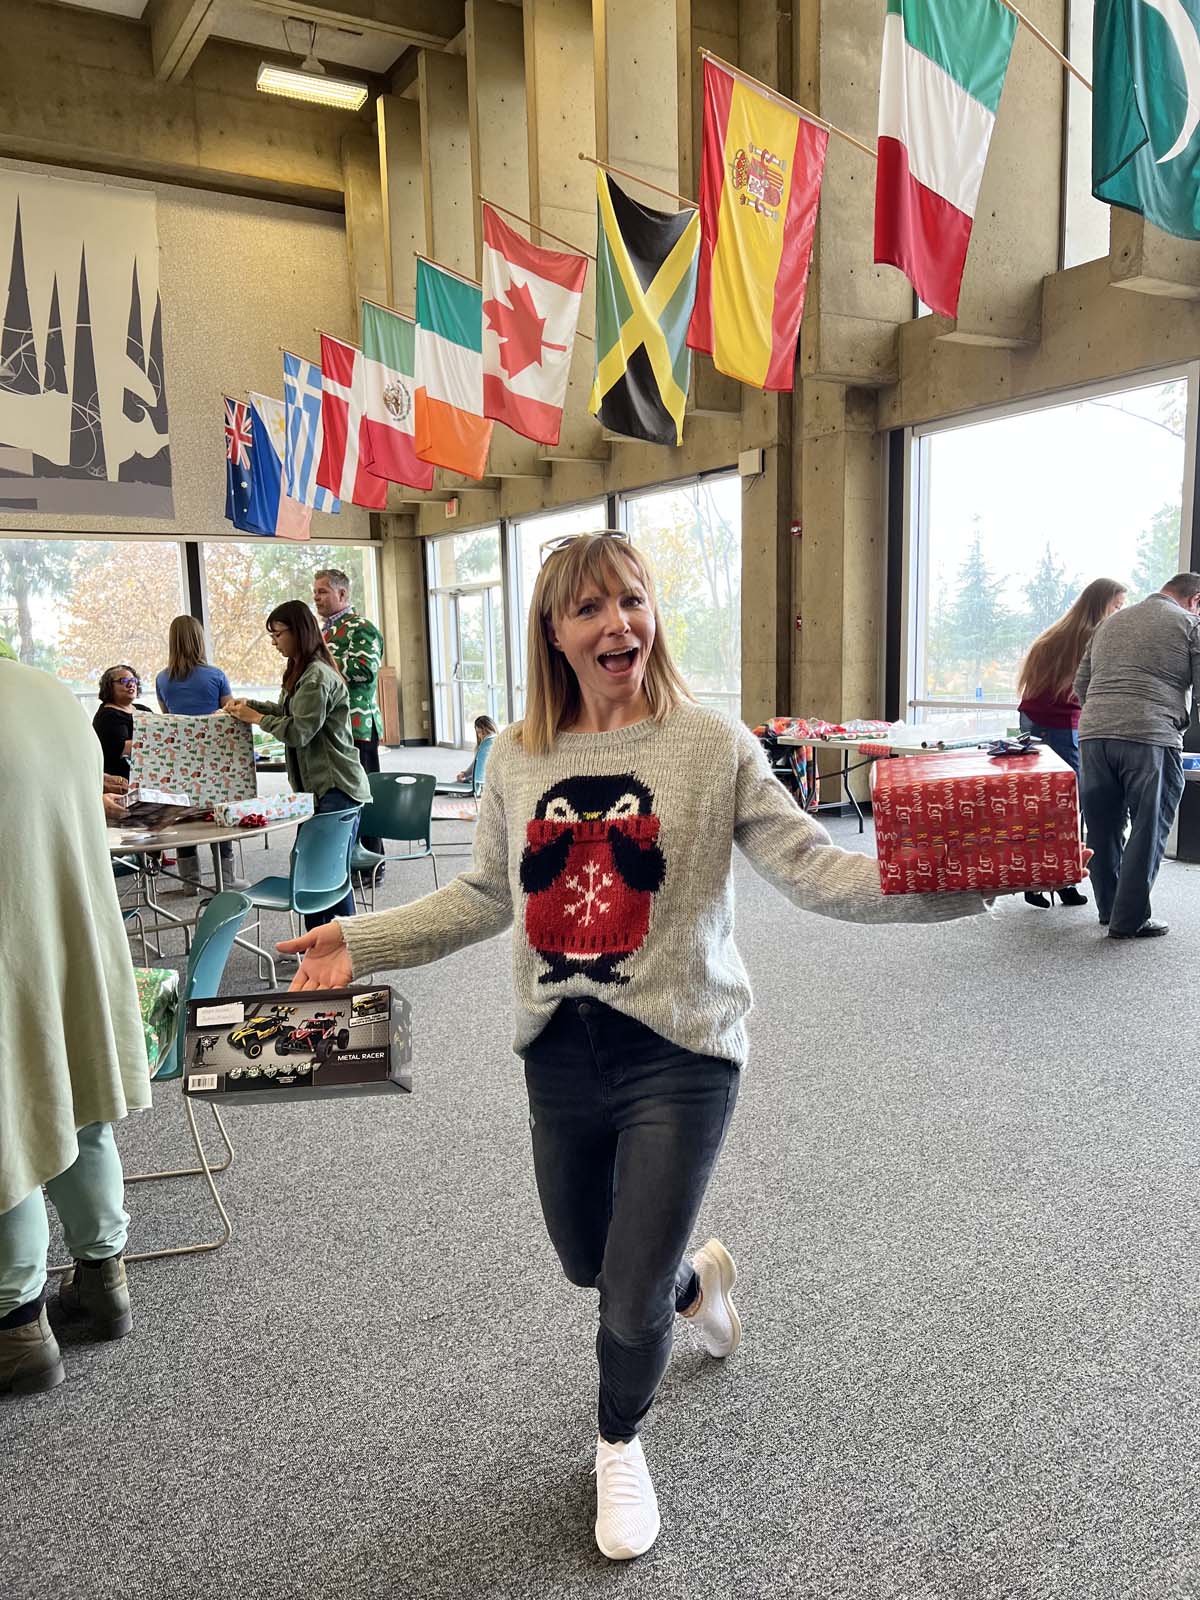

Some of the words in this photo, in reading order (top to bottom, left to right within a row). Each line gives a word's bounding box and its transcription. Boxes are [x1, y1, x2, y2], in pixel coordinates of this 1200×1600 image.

[926, 802, 944, 822] Let
[958, 799, 975, 819] Let
[990, 796, 1008, 816] Let
[1023, 793, 1040, 814] Let
[895, 805, 912, 825] Let
[337, 1054, 360, 1062] METAL
[361, 1052, 385, 1060] RACER
